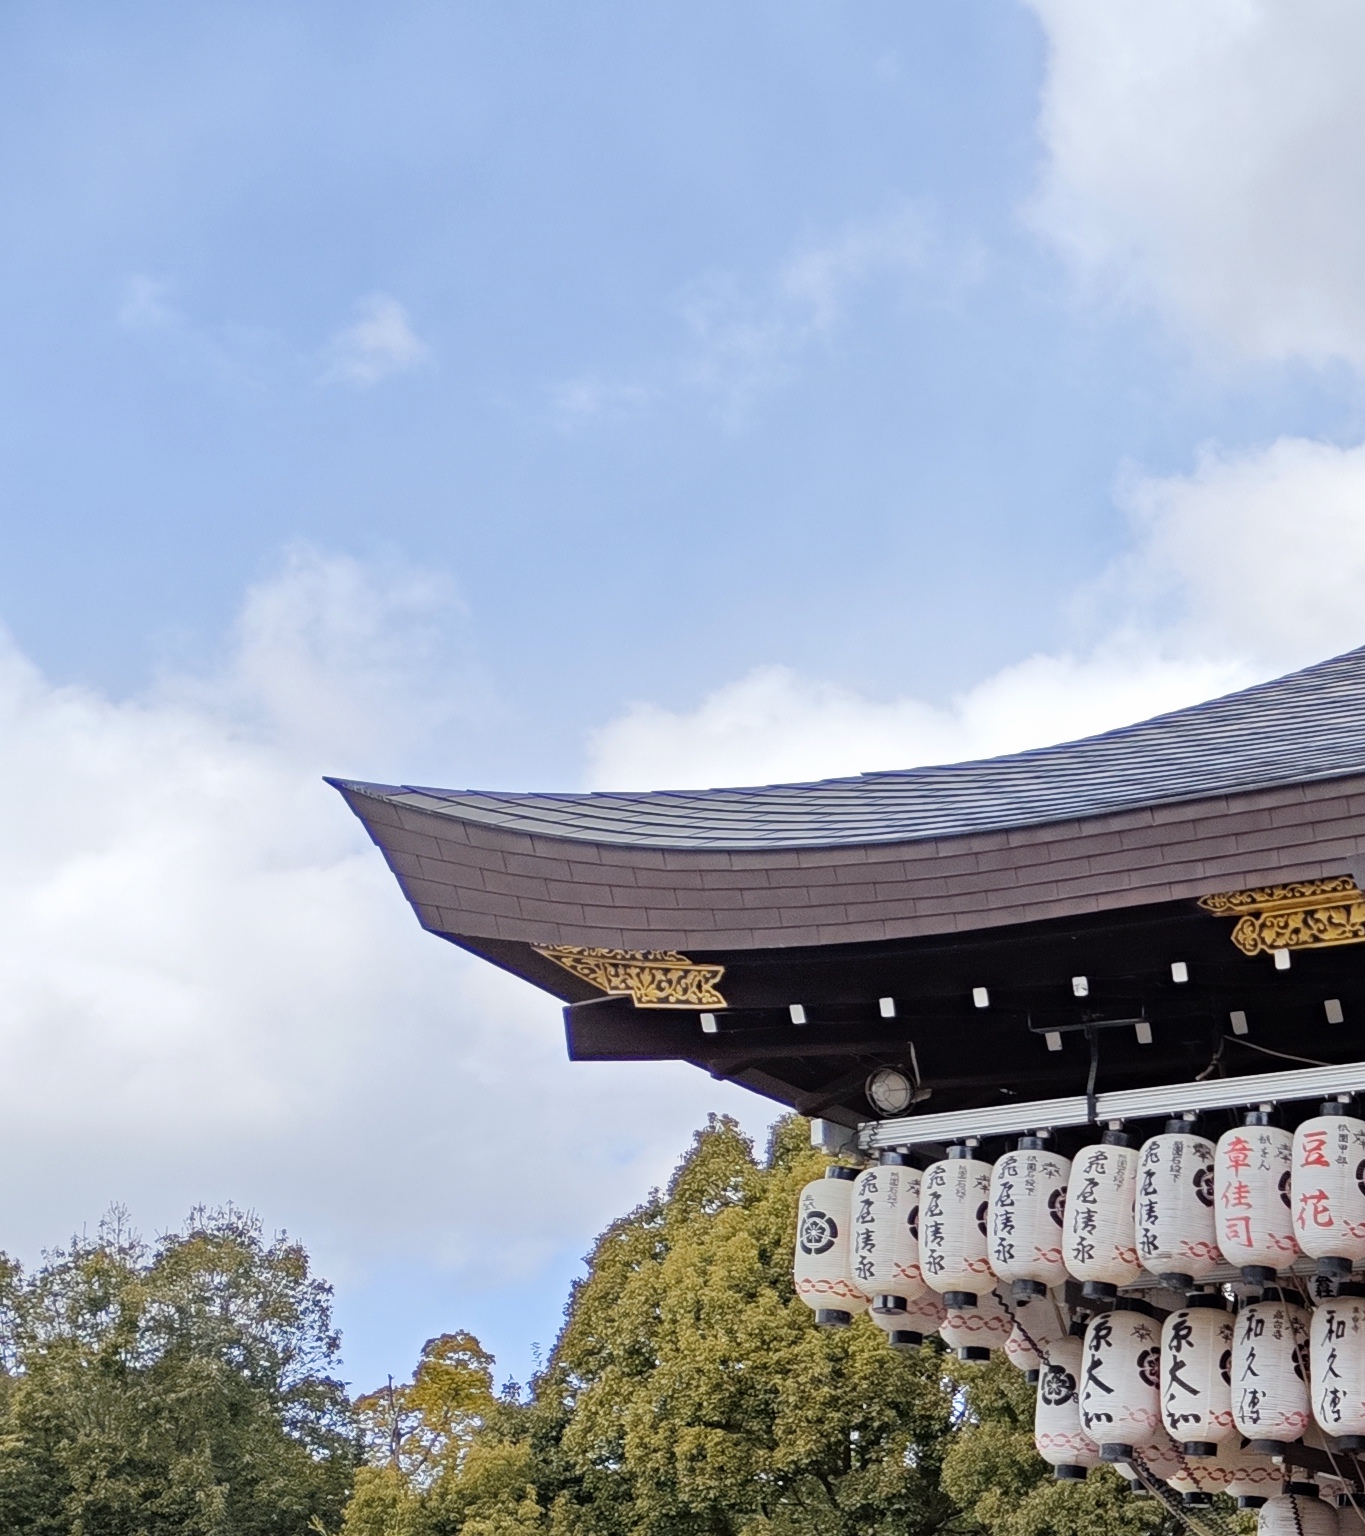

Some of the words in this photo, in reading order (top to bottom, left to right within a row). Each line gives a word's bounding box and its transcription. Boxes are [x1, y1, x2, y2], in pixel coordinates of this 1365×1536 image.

[1221, 1136, 1253, 1248] 章佳司
[1296, 1130, 1334, 1231] 豆花
